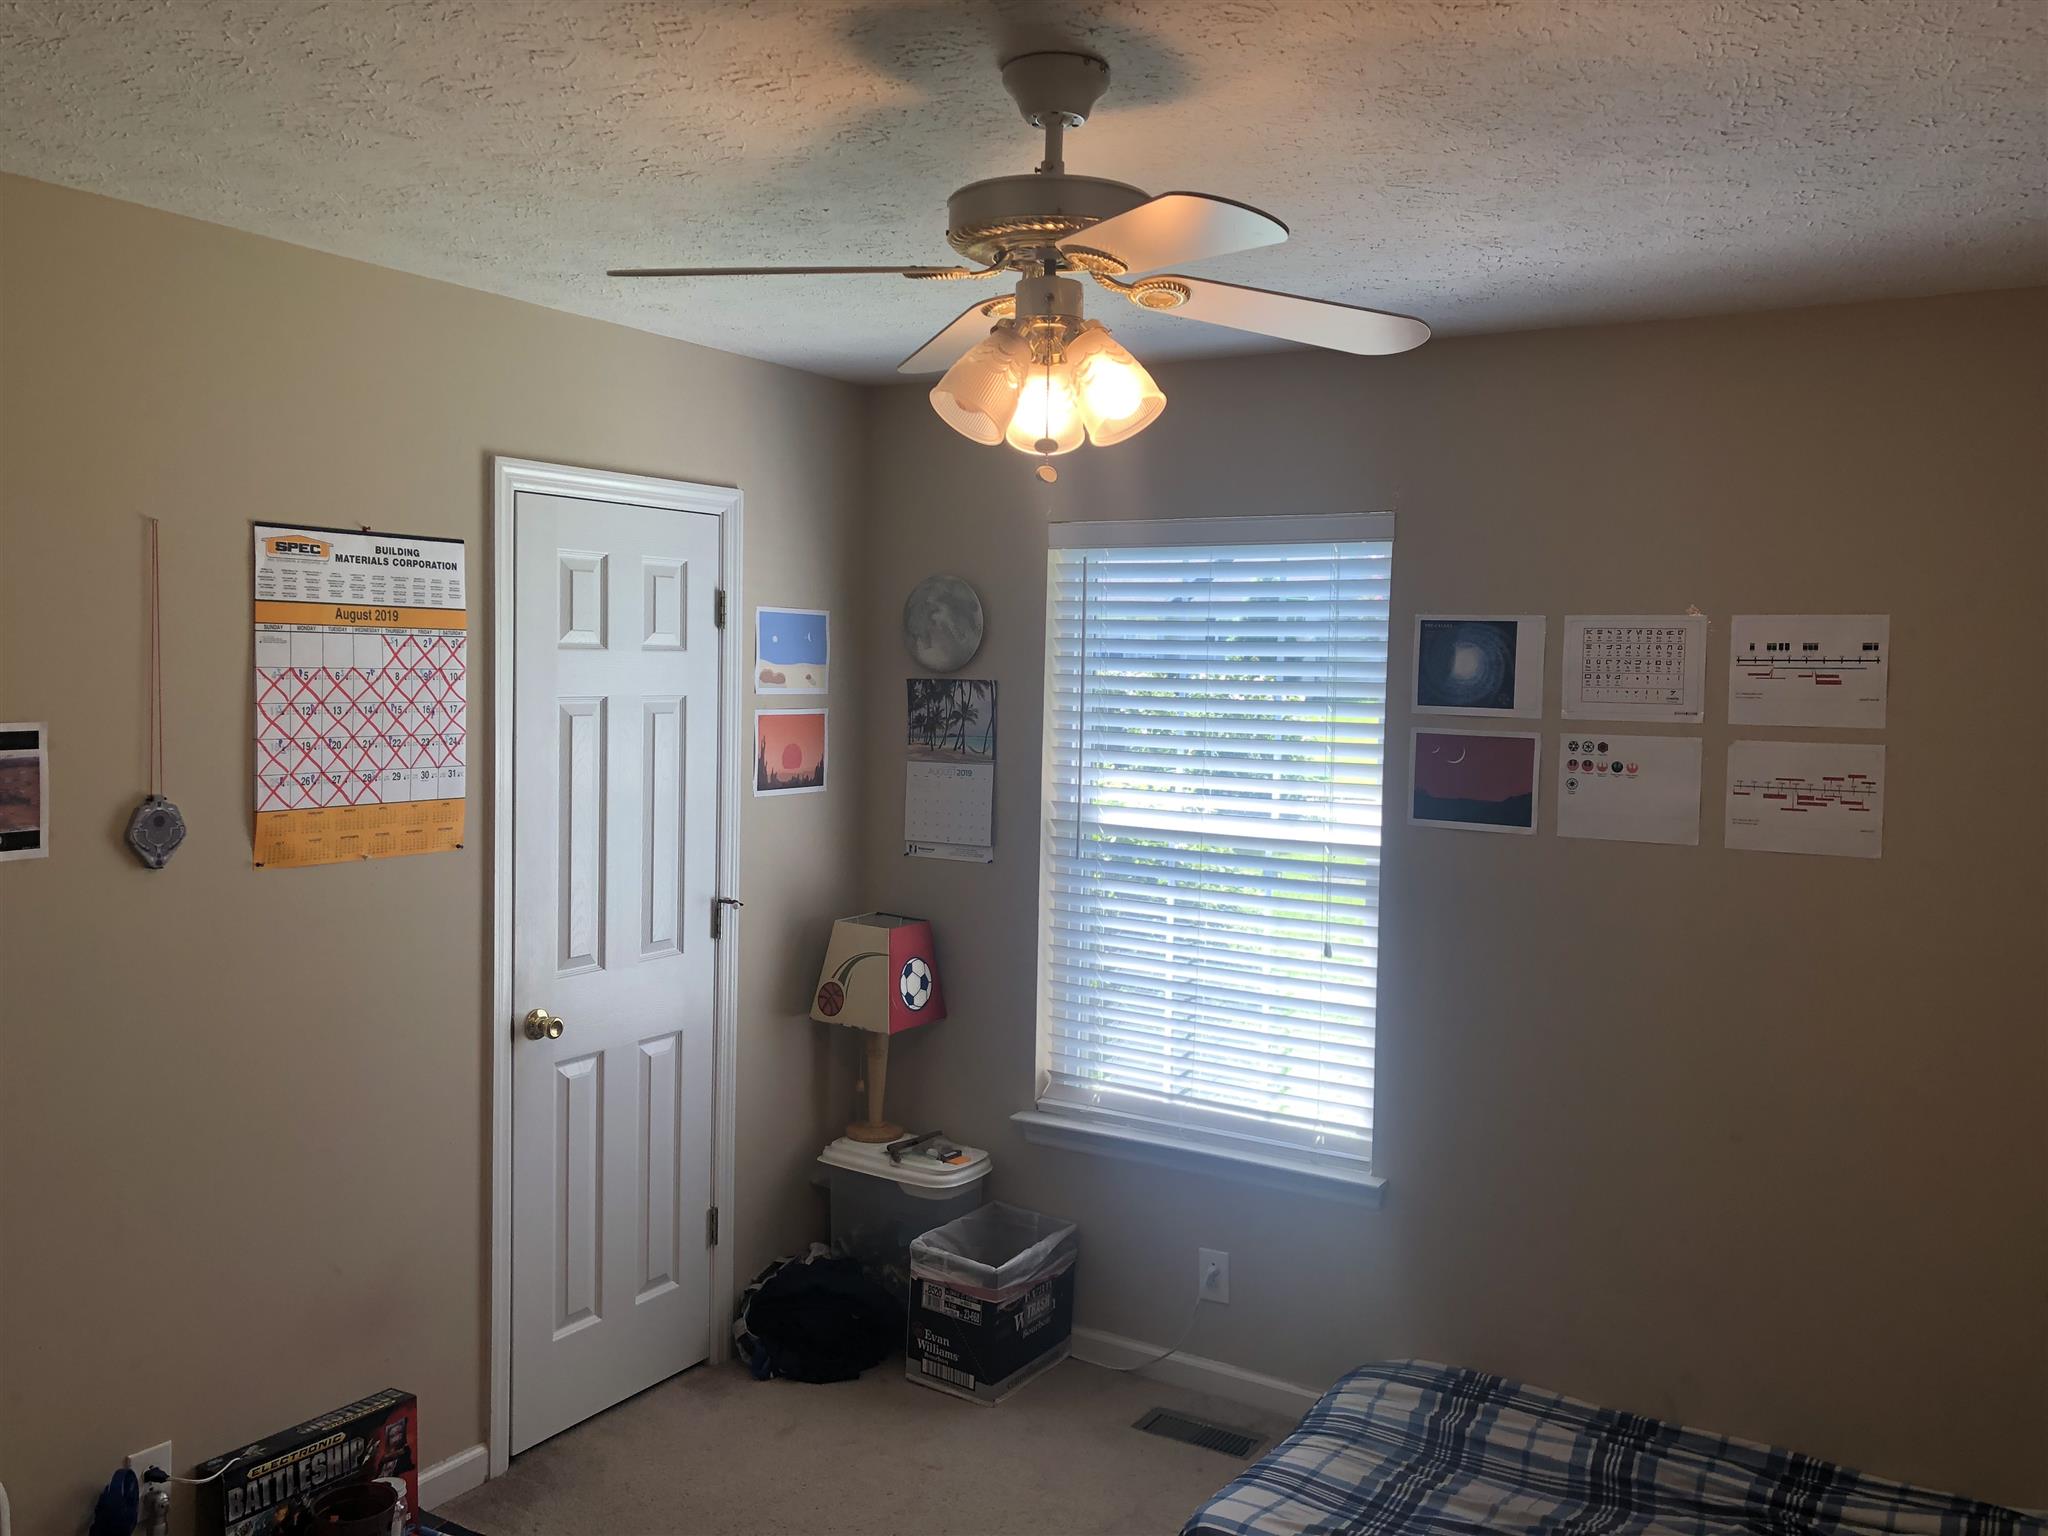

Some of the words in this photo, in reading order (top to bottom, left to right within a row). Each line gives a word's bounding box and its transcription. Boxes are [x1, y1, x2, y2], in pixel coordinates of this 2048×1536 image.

[275, 541, 321, 554] SPEC
[375, 545, 420, 558] BUILDING
[335, 553, 389, 567] MATERIALS
[393, 557, 457, 571] CORPORATION
[335, 607, 372, 623] August
[375, 609, 399, 622] 2019
[423, 639, 429, 649] 2
[450, 640, 456, 649] 3
[304, 671, 309, 681] 5
[335, 671, 341, 681] 6
[395, 671, 400, 681] 8
[449, 671, 458, 681] 10
[302, 706, 311, 716] 12
[333, 706, 342, 715] 13
[364, 705, 373, 714] 14
[394, 705, 402, 714] 15
[422, 705, 430, 714] 16
[449, 704, 458, 713] 17
[302, 741, 311, 751] 19
[332, 740, 342, 750] 20
[392, 738, 401, 748] 22
[301, 776, 311, 786] 26
[332, 775, 341, 784] 27
[362, 773, 372, 783] 28
[392, 772, 402, 781] 29
[420, 770, 430, 780] 30
[448, 769, 456, 778] 31
[956, 768, 974, 777] 2019
[923, 1328, 950, 1347] Evan
[916, 1336, 959, 1362] Williams
[251, 1433, 343, 1477] ELECTRONIC
[227, 1435, 367, 1523] BATTLESHIP
